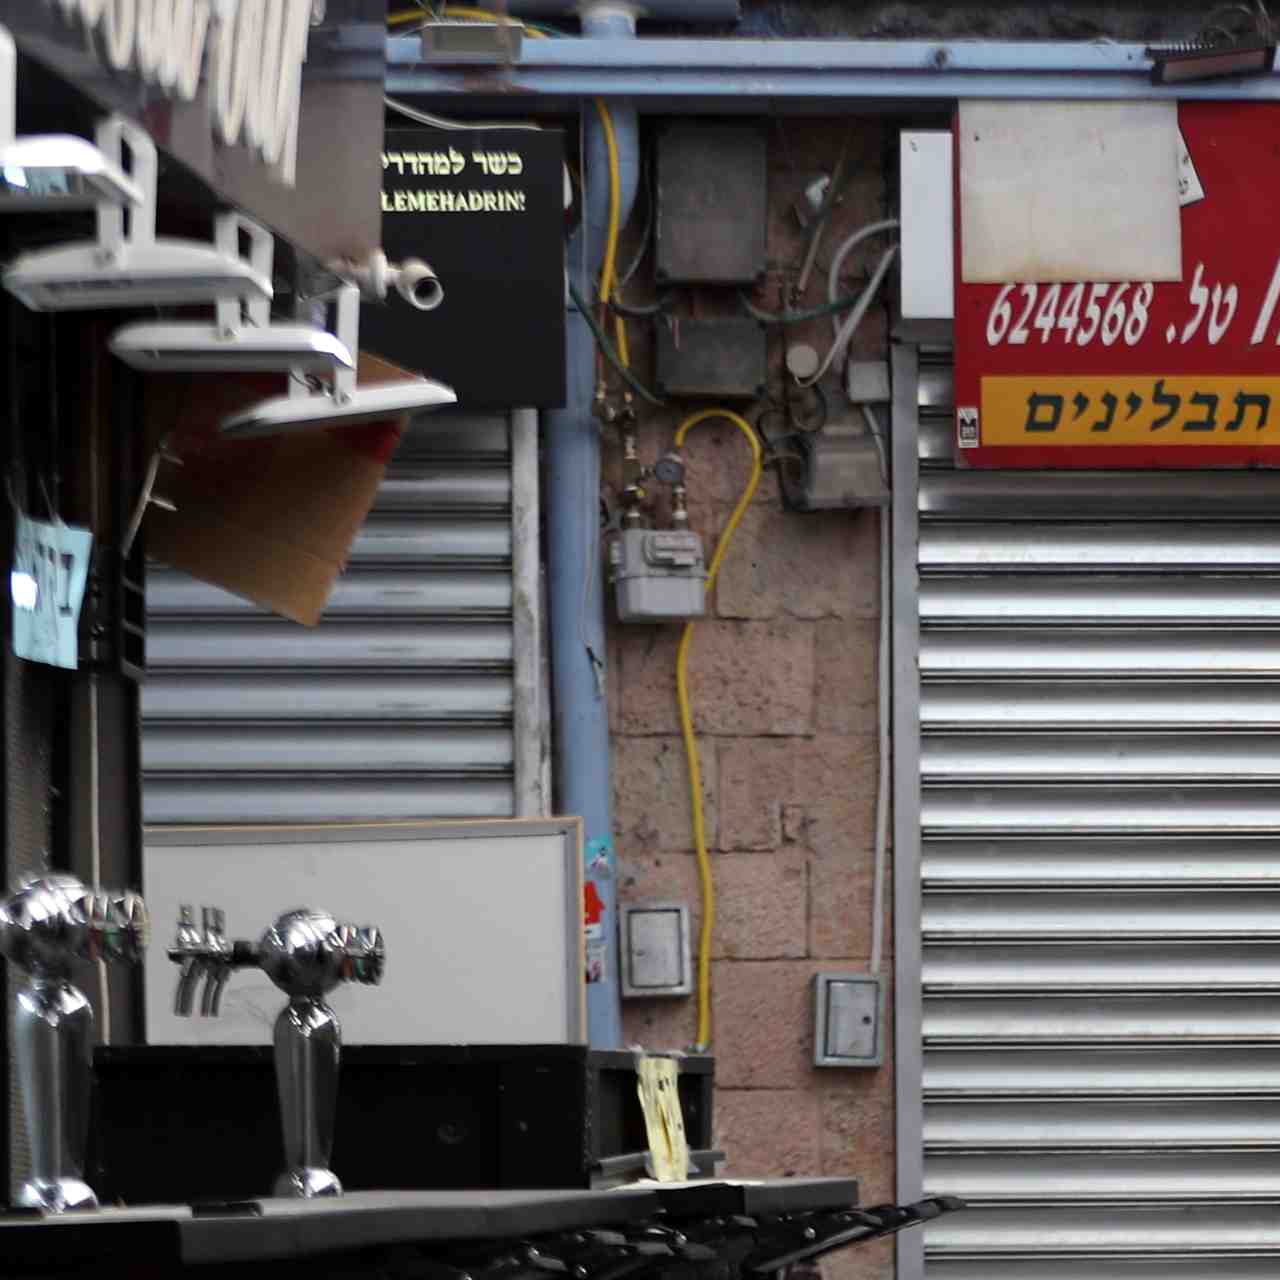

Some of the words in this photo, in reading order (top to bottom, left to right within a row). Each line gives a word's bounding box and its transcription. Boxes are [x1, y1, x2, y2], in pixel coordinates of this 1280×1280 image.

[381, 146, 466, 176] למהדרי
[471, 151, 524, 176] כשר
[986, 283, 1154, 346] 6244568
[1166, 263, 1238, 345] טל.
[1024, 380, 1271, 433] תבלינים
